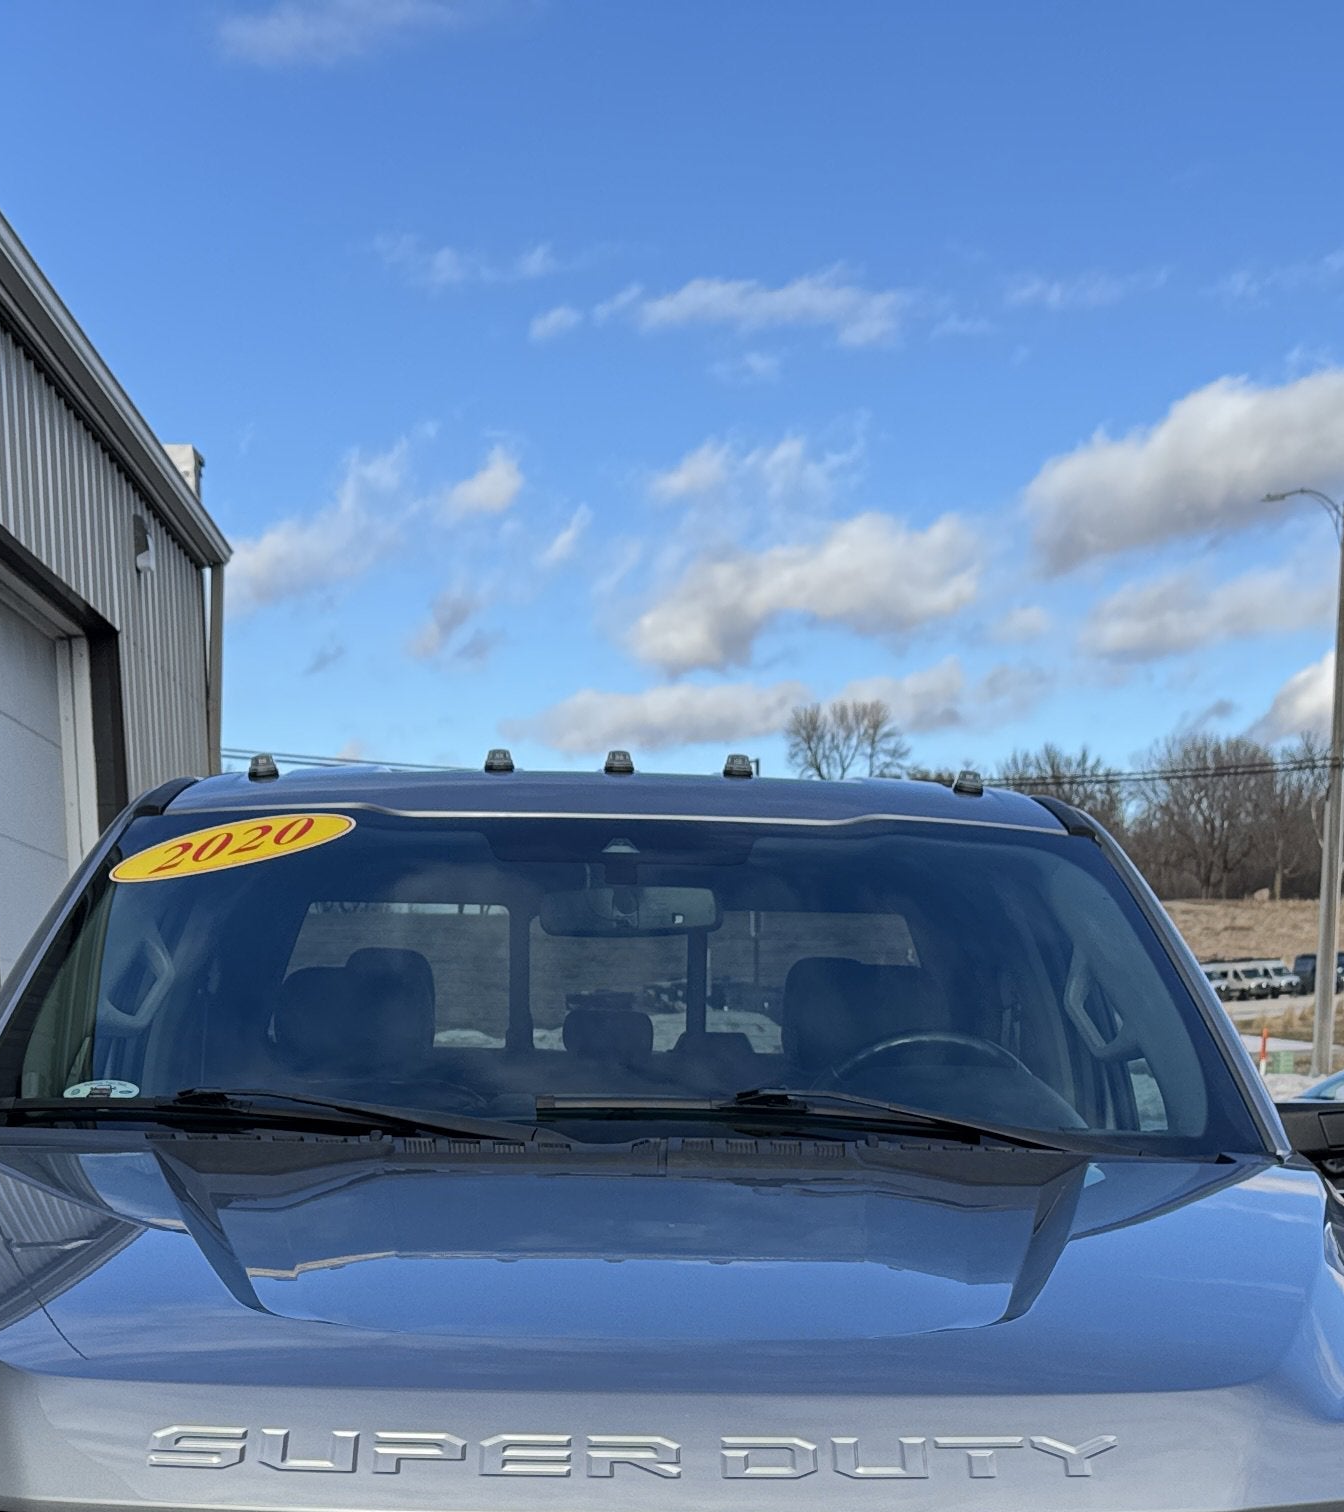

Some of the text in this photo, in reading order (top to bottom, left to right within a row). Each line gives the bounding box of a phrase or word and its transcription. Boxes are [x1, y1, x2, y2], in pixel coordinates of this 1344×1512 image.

[148, 818, 315, 875] 2020
[147, 1425, 1118, 1481] SUPER DUTY
